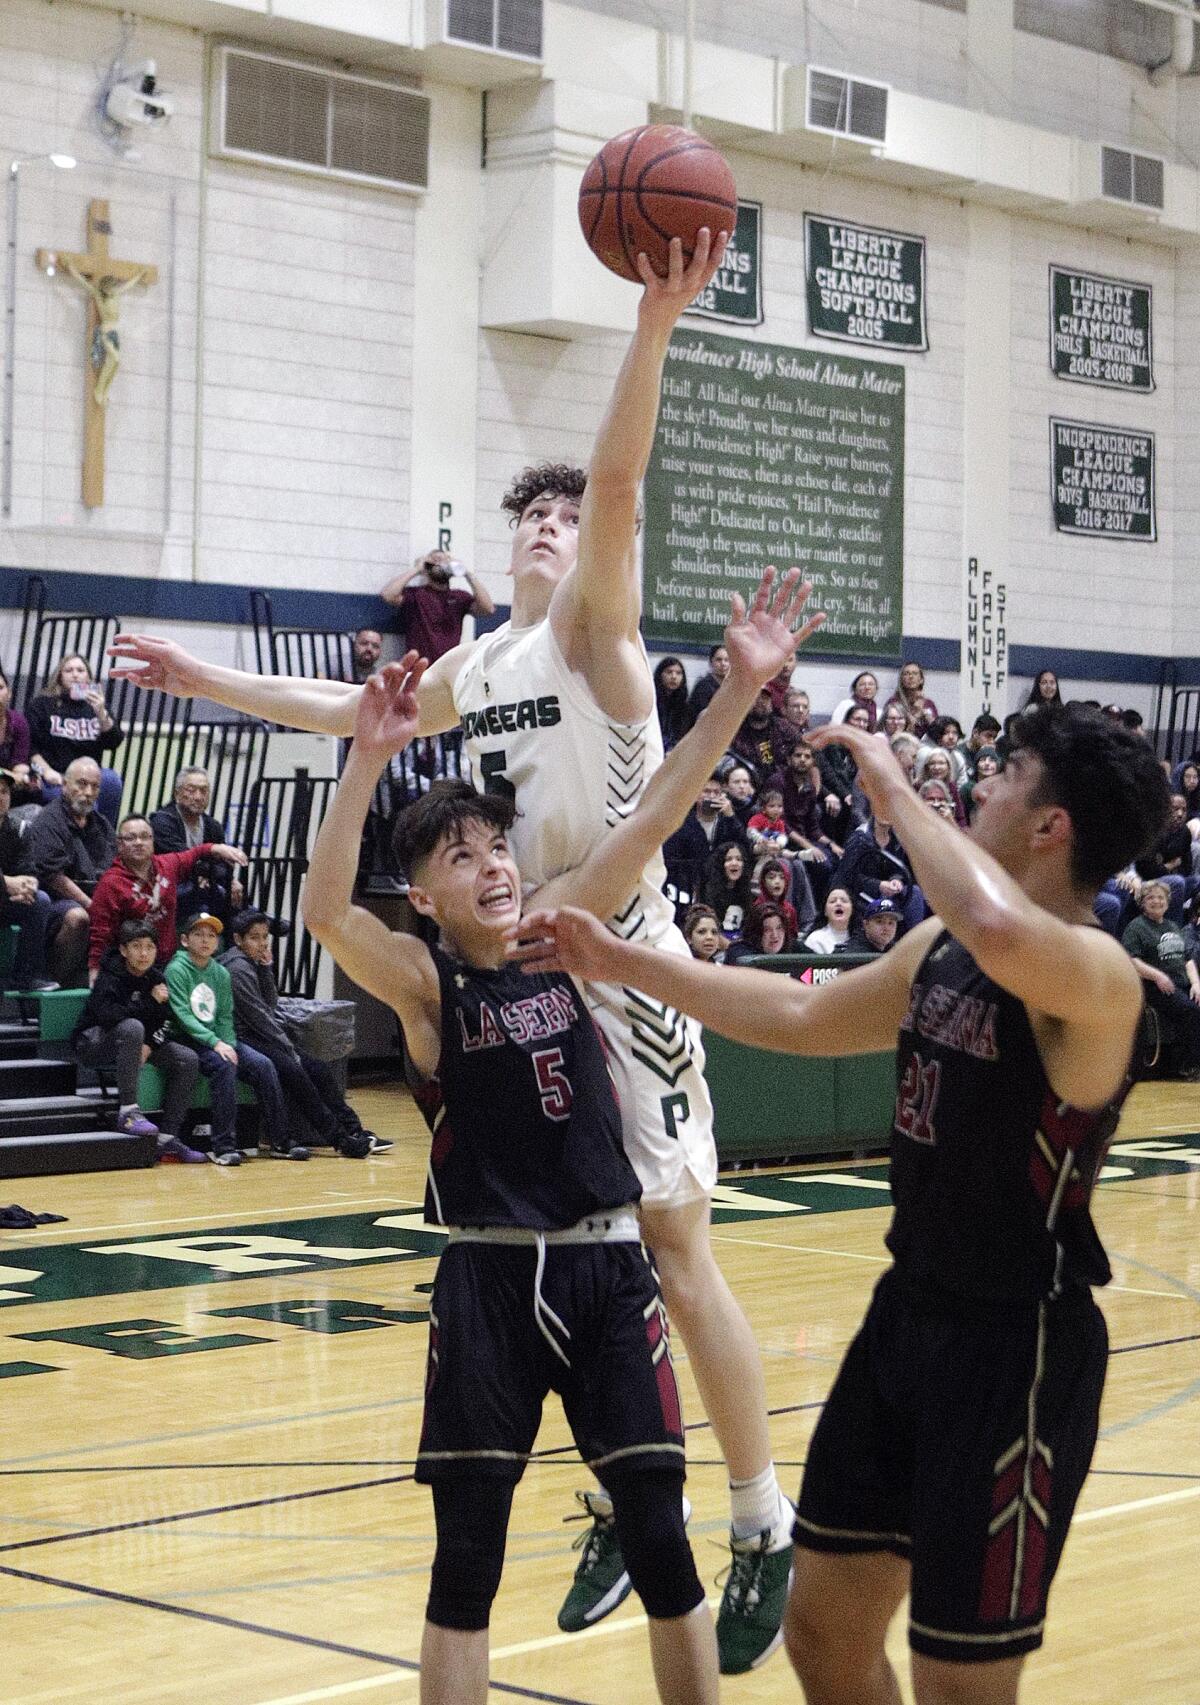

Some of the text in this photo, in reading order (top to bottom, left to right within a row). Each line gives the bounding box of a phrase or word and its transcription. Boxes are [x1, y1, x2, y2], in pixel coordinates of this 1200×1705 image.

[828, 226, 904, 259] LIBERTY
[832, 248, 903, 280] LEAGUE
[815, 267, 916, 304] CHAMPIONS
[1069, 278, 1133, 307] LIBERTY
[820, 288, 913, 325] SOFTBALL
[1072, 297, 1132, 326] LEAGUE
[847, 314, 884, 340] 2005
[1059, 314, 1144, 347] CHAMPIONS
[666, 341, 902, 395] ovidence High School Alma Mater
[1089, 338, 1149, 367] BASKETBALL
[662, 401, 681, 421] the
[709, 408, 750, 433] Proudly
[753, 421, 768, 434] we
[772, 417, 789, 436] her
[791, 426, 813, 440] sons
[816, 425, 835, 443] and
[698, 382, 715, 401] All
[718, 385, 738, 405] hail
[741, 393, 759, 408] our
[763, 392, 792, 413] Alma
[796, 398, 826, 418] Mater
[830, 406, 858, 424] praise
[861, 407, 877, 425] her
[880, 415, 891, 427] to
[693, 431, 752, 456] Providence
[795, 444, 822, 464] Raise
[824, 454, 848, 471] your
[1057, 427, 1148, 458] INDEPENDENCE
[1074, 448, 1133, 474] LEAGUE
[662, 454, 686, 472] raise
[689, 461, 714, 478] your
[755, 464, 779, 484] then
[782, 474, 793, 485] as
[795, 470, 829, 490] echoes
[853, 478, 875, 496] each
[878, 480, 892, 497] of
[1062, 466, 1145, 495] CHAMPIONS
[674, 485, 686, 497] us
[689, 482, 713, 501] with
[717, 486, 745, 506] pride
[824, 497, 880, 519] Providence
[1058, 485, 1149, 515] BOYS BASKETBALL
[438, 501, 452, 552] PR
[711, 508, 766, 531] Dedicated
[768, 518, 779, 532] to
[782, 516, 805, 535] Our
[838, 524, 882, 543] steadfast
[666, 527, 709, 554] through
[713, 532, 731, 551] the
[767, 540, 791, 558] with
[794, 541, 813, 559] her
[814, 546, 848, 564] mantle
[851, 552, 865, 564] on
[671, 553, 721, 575] shoulders
[830, 569, 845, 587] So
[848, 576, 859, 588] as
[656, 577, 692, 598] before
[695, 586, 706, 599] us
[879, 597, 890, 614] all
[682, 609, 702, 624] our
[967, 556, 978, 688] ALUMNI
[996, 584, 1006, 689] STAFF
[456, 984, 578, 1052] LA SERN
[532, 1047, 573, 1122] 5
[895, 1050, 941, 1146] 21
[660, 1091, 691, 1141] P
